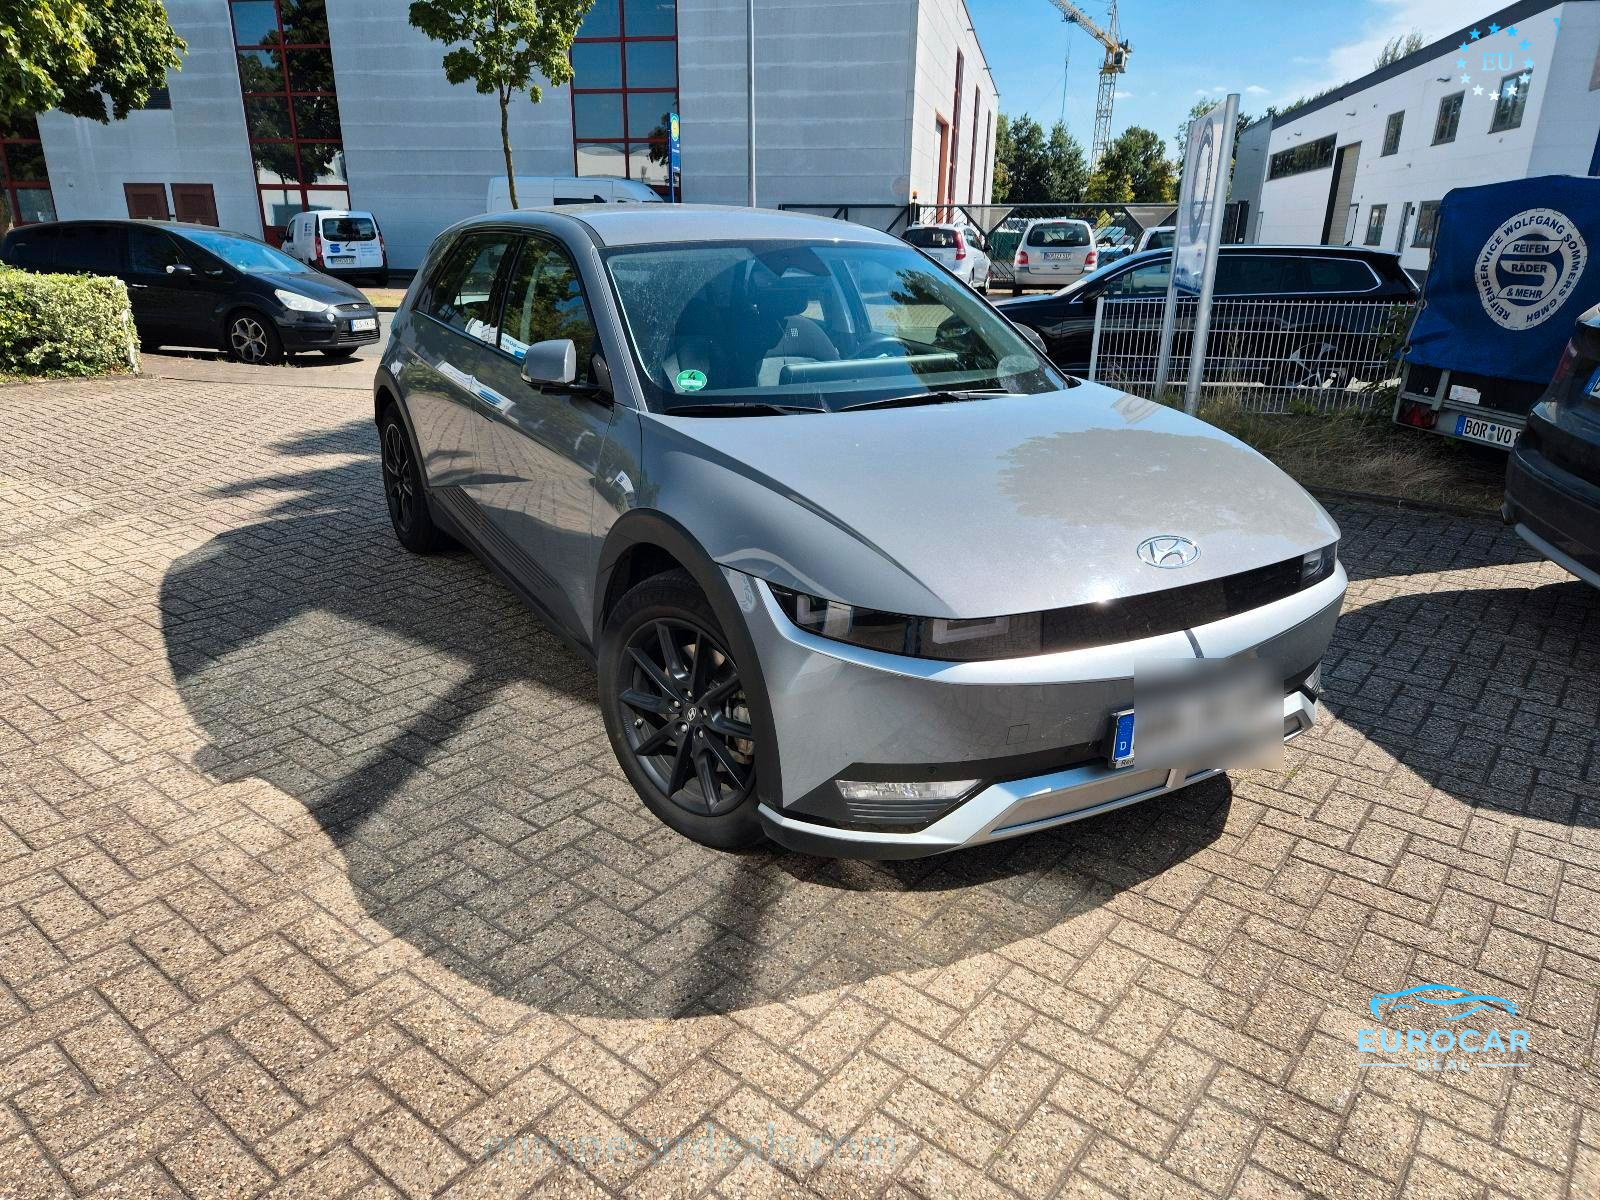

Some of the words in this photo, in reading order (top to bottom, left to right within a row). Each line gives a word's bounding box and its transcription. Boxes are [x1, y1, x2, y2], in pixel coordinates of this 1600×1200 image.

[1503, 215, 1565, 237] WOLFGANG
[1513, 243, 1550, 253] REIFEN
[1511, 262, 1548, 273] RÄDER
[1558, 233, 1582, 297] SOMMERS
[1480, 237, 1511, 320] REIFENSERVICE
[1506, 287, 1514, 297] &
[1514, 287, 1543, 299] MEHR
[1526, 299, 1557, 323] GMBH
[688, 371, 696, 380] 4
[1464, 419, 1488, 438] BOR
[1496, 426, 1513, 444] VO
[1120, 741, 1126, 750] D
